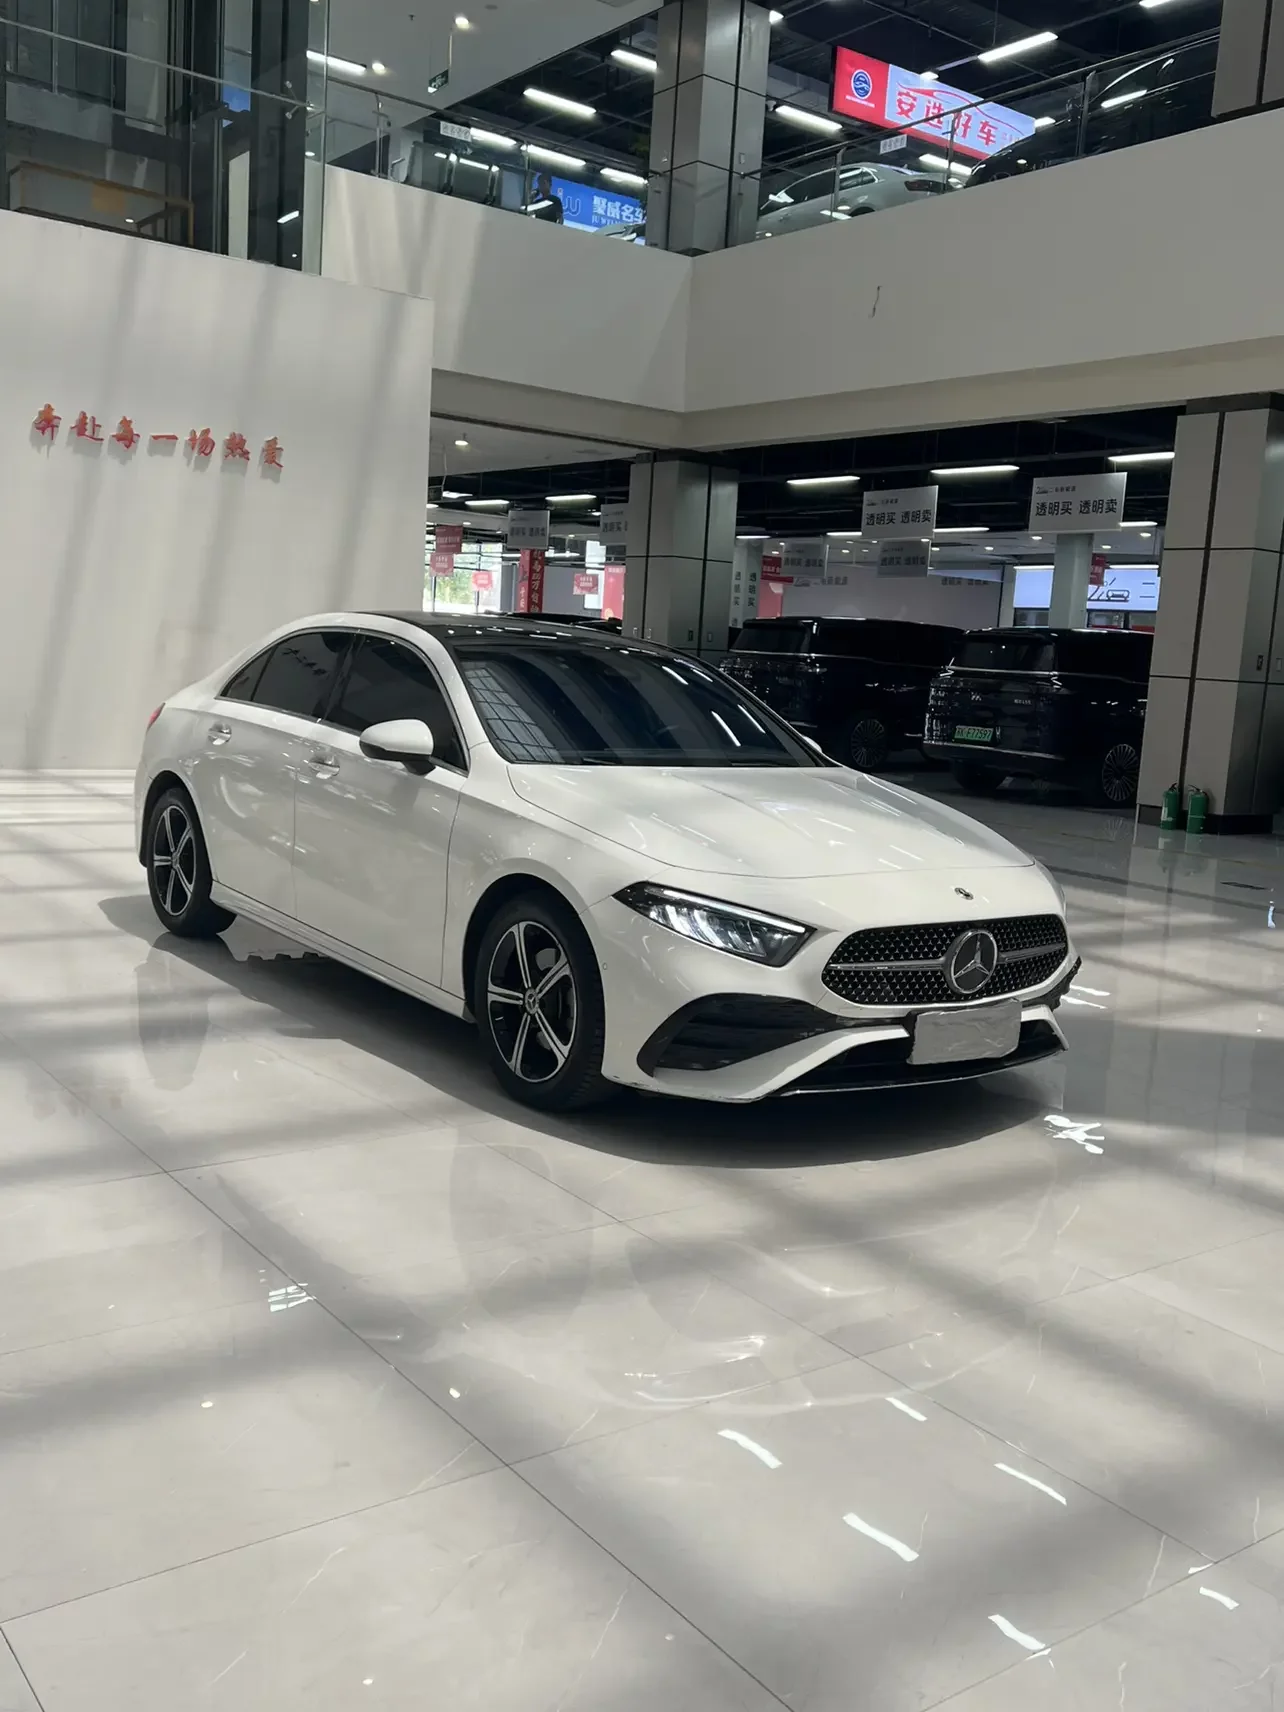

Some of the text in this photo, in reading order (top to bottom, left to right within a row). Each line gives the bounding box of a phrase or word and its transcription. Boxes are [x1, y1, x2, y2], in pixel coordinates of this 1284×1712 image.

[32, 403, 284, 468] 奔赴每一场热爱
[1035, 498, 1118, 517] 透明买 透明卖
[865, 509, 932, 527] 透明买 透明卖
